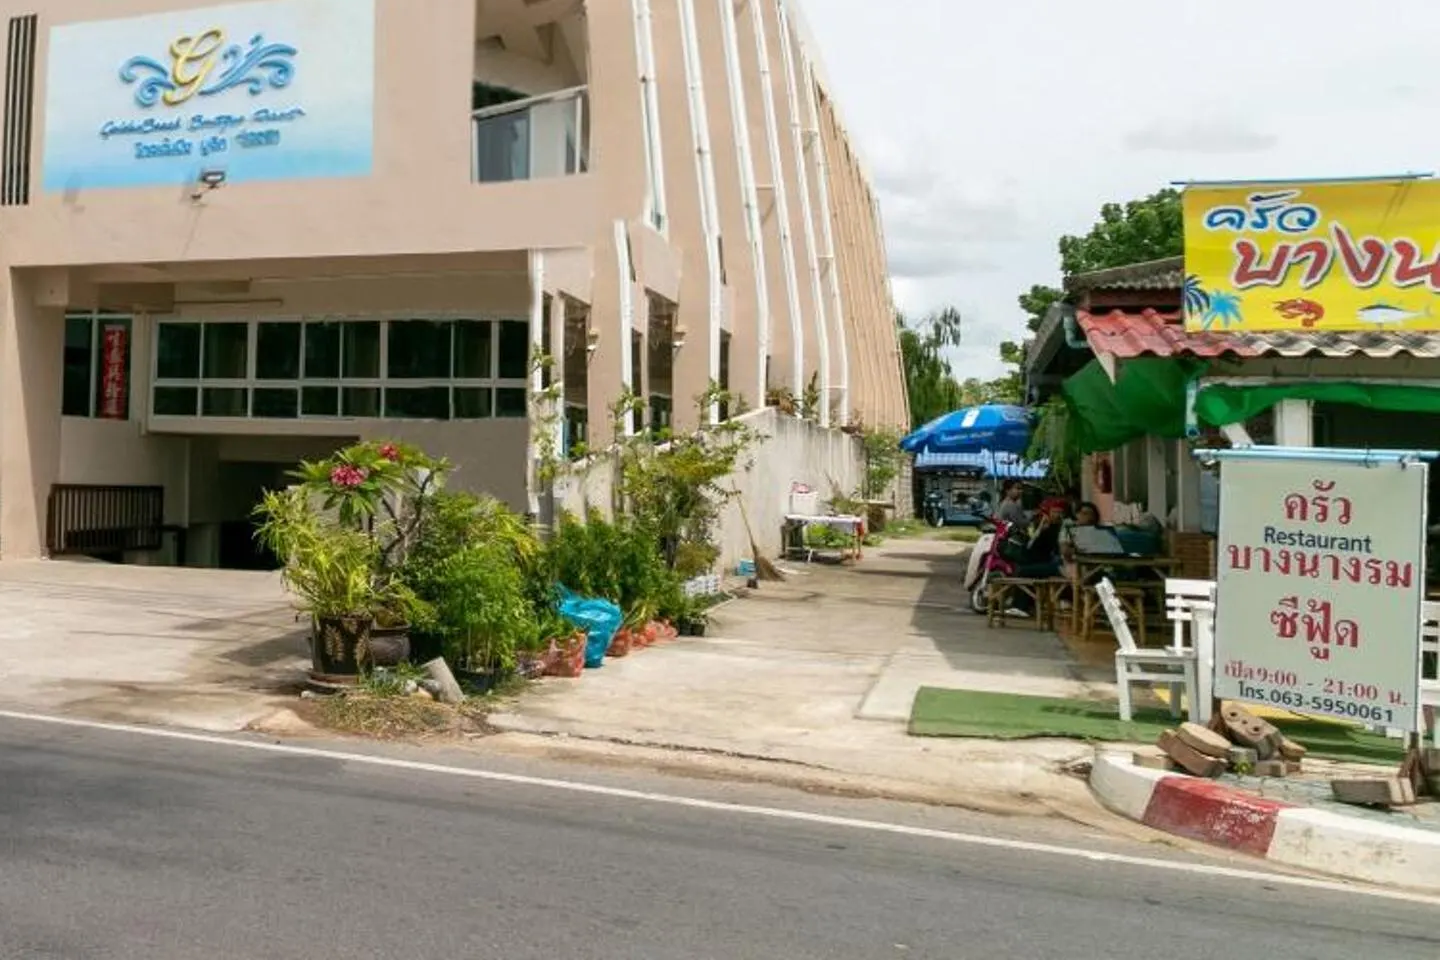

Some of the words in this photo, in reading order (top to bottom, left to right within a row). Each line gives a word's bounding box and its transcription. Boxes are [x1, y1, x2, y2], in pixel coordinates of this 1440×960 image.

[1205, 191, 1318, 233] ครัว
[1284, 478, 1352, 525] ครัว
[1264, 526, 1372, 553] Restaurant
[1227, 544, 1414, 588] บางนางรม
[1323, 677, 1378, 700] 21:00
